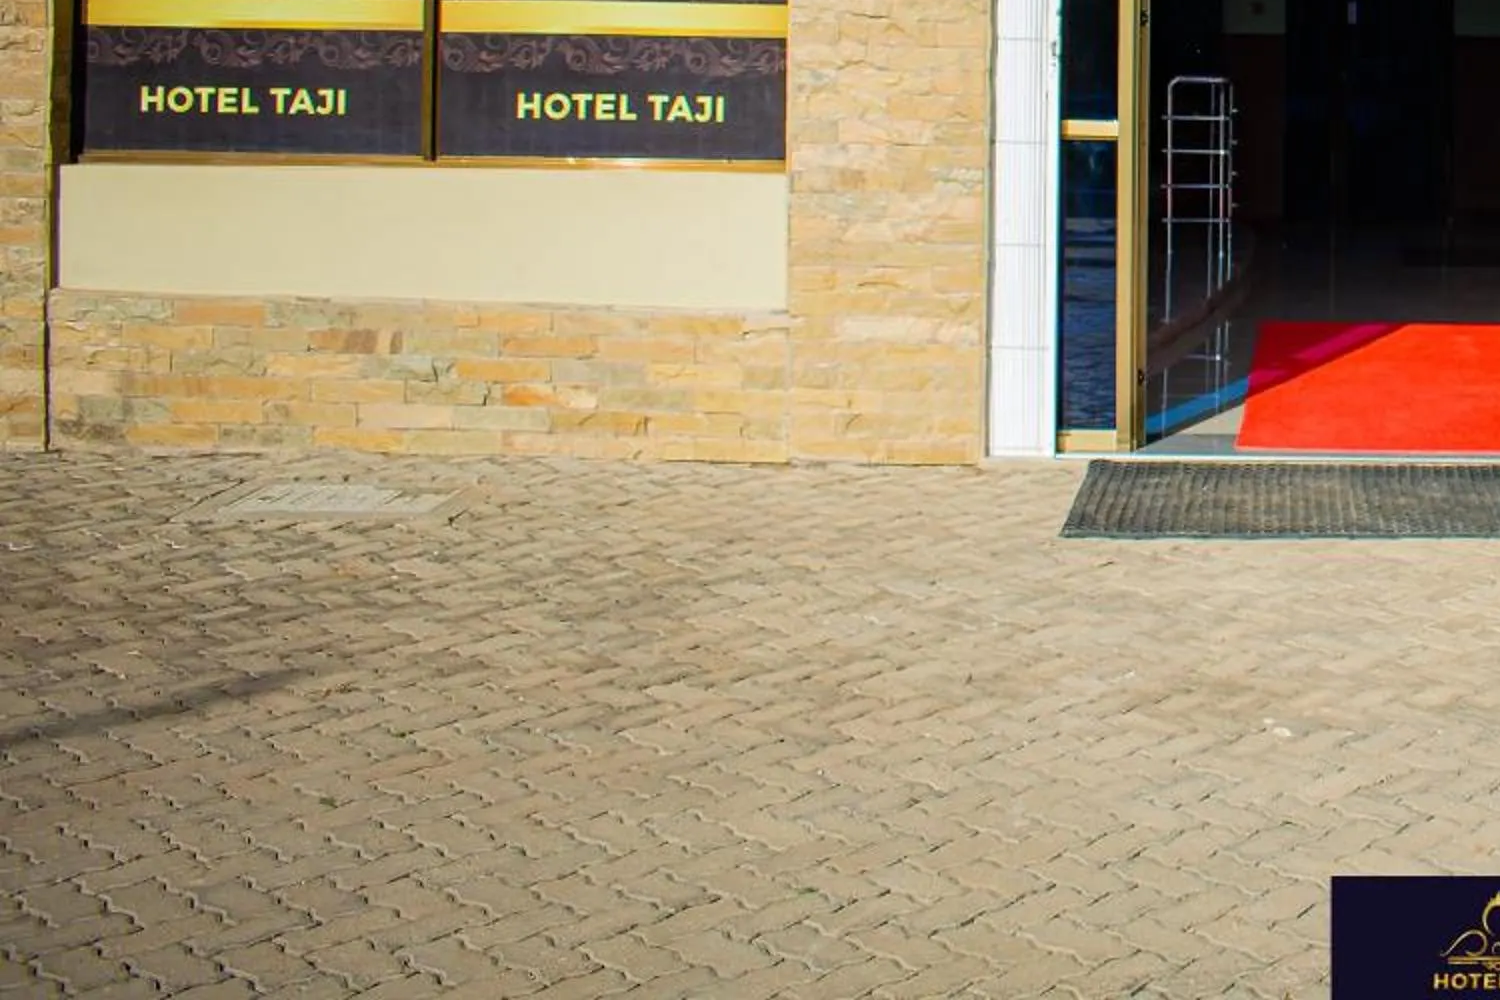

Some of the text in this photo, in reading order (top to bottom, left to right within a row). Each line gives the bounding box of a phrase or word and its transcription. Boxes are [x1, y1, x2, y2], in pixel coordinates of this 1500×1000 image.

[140, 85, 346, 116] HOTEL TAJI
[516, 92, 725, 123] HOTEL TAJI
